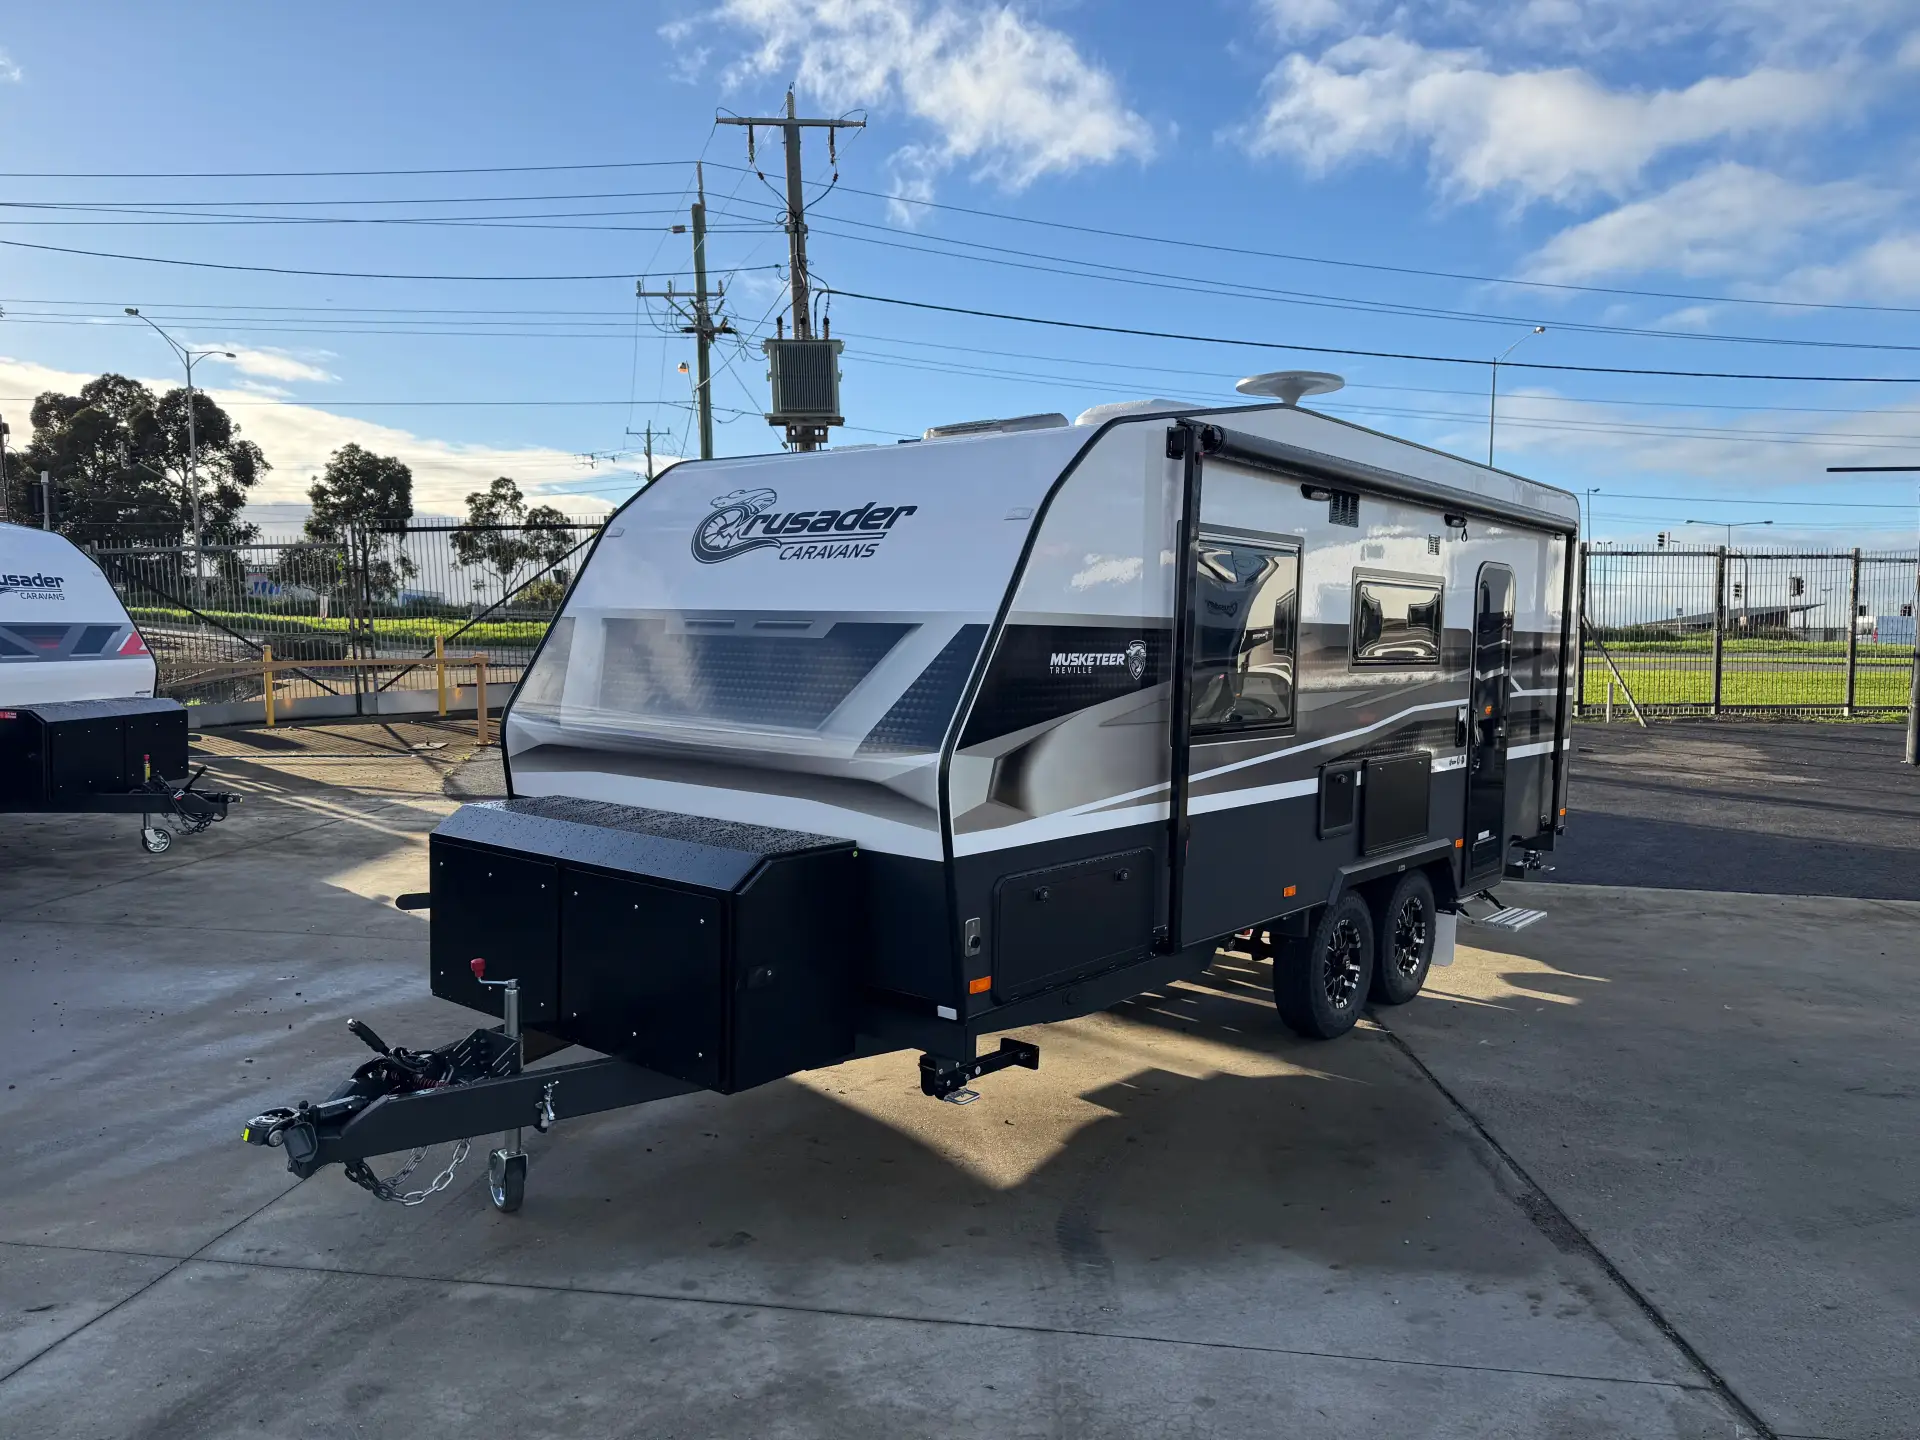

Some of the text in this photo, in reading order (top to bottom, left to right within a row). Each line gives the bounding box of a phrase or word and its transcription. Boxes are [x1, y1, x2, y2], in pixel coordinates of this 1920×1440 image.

[691, 502, 918, 564] Crusader
[778, 543, 880, 561] CARAVANS
[20, 592, 65, 601] CARAVANS
[1050, 653, 1126, 666] MUSKETEER
[1049, 666, 1093, 674] TREVILLE
